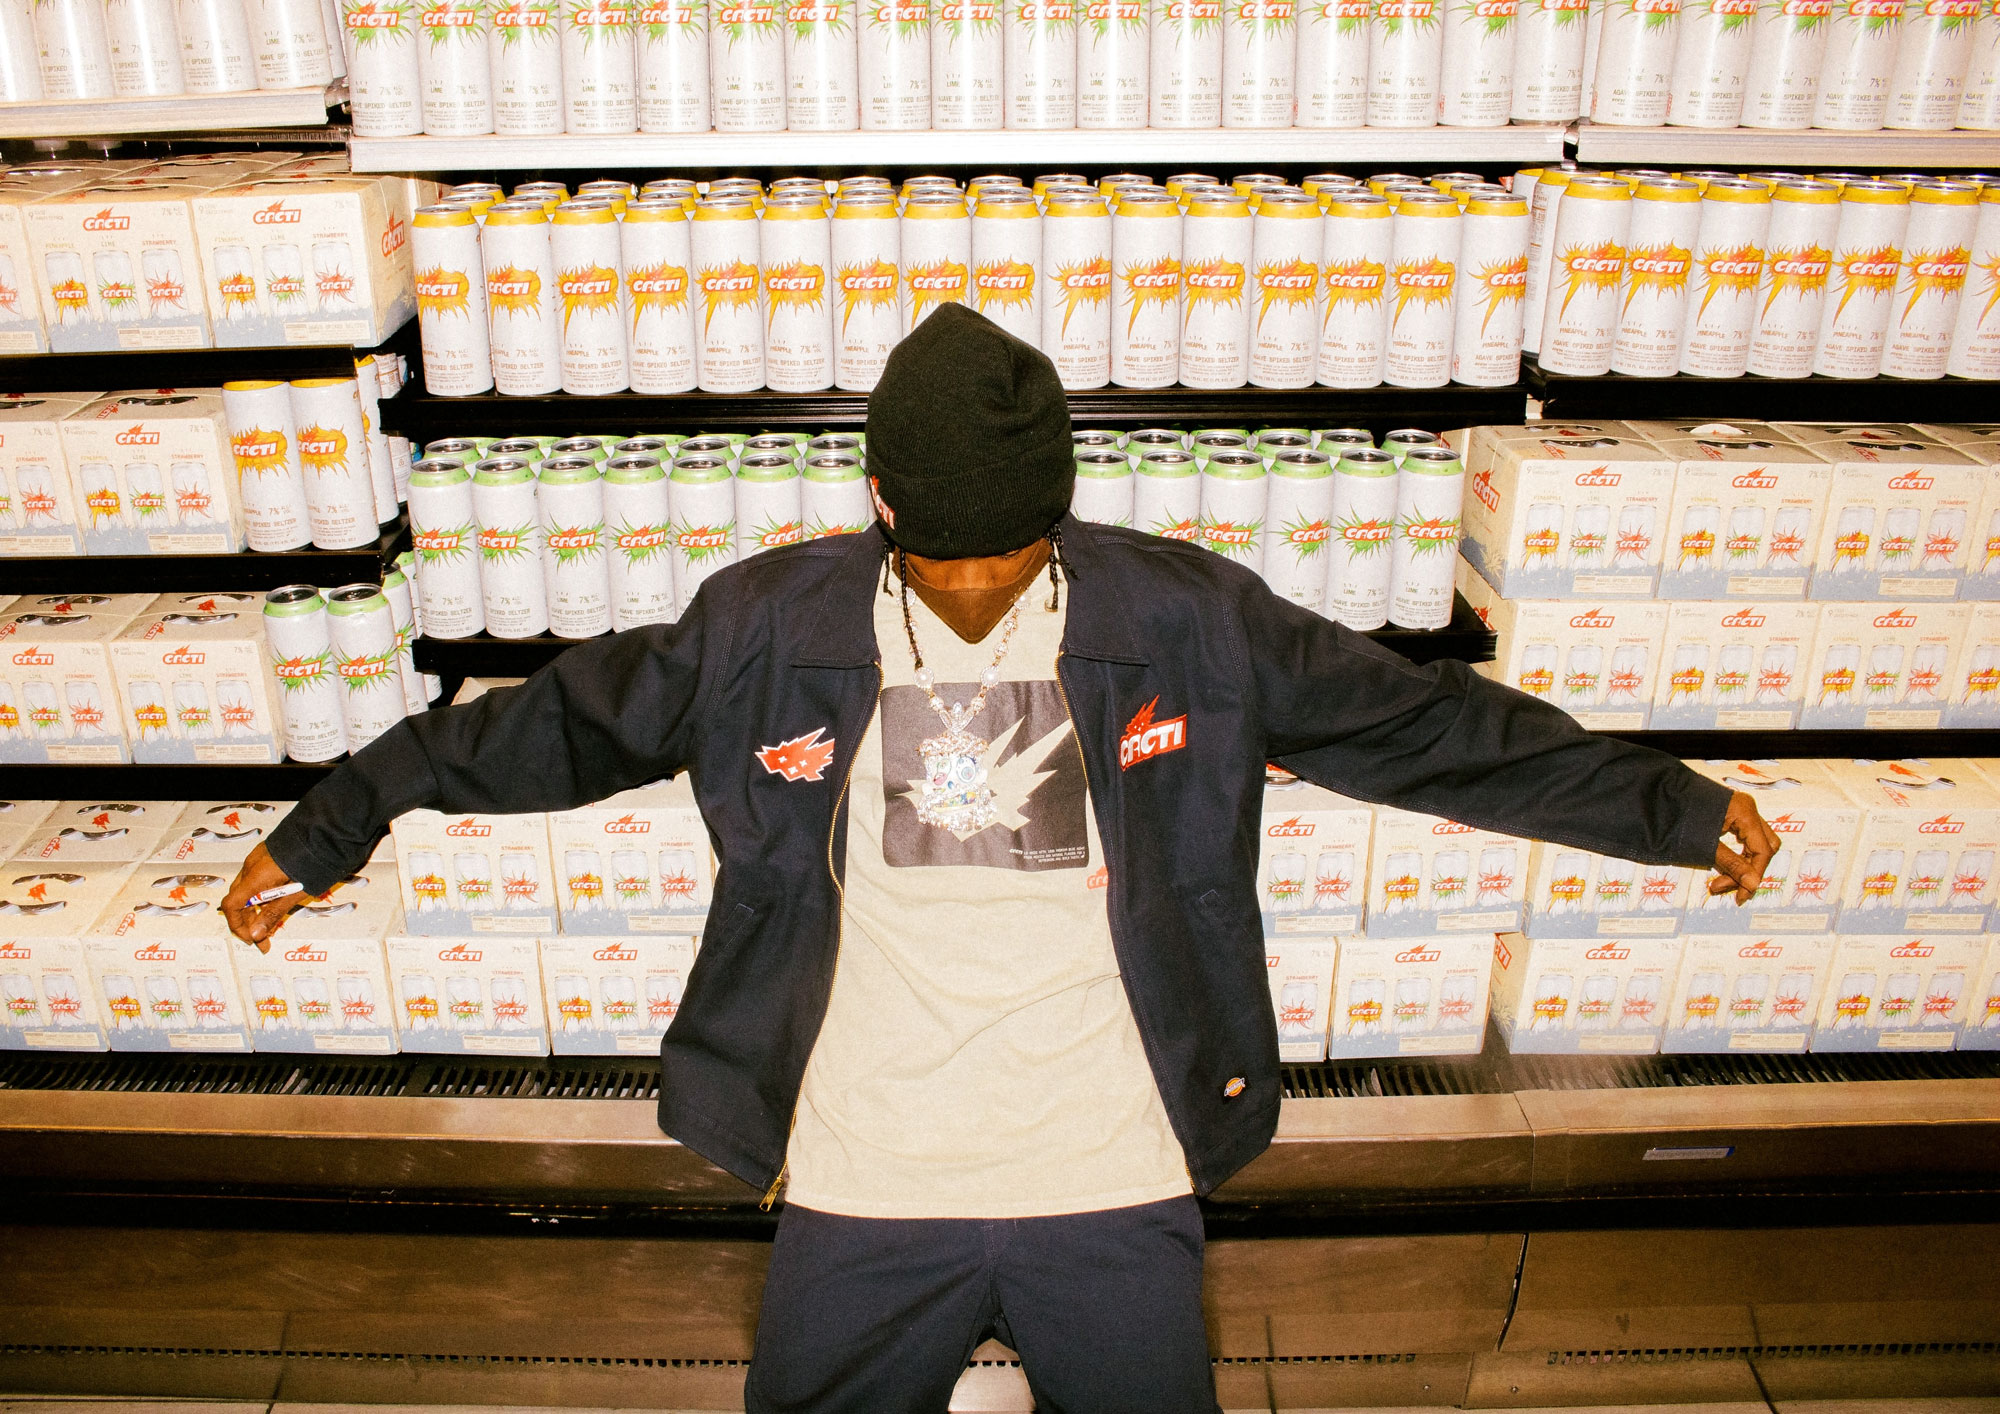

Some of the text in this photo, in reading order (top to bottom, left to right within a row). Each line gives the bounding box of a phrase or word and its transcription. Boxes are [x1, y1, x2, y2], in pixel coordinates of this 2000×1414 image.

[575, 8, 626, 25] CACTI
[641, 7, 691, 23] CACTI
[721, 6, 772, 23] CACTI
[787, 5, 837, 22] CACTI
[877, 5, 926, 22] CACTI
[942, 4, 994, 20] CACTI
[1087, 3, 1140, 19] CACTI
[1240, 2, 1292, 18] CACTI
[1379, 0, 1433, 18] CACTI
[347, 11, 399, 27] CACTI
[423, 10, 474, 26] CACTI
[496, 10, 546, 26] CACTI
[83, 216, 130, 231] CACTI
[253, 209, 301, 224] CACTI
[382, 221, 405, 257] CACTI
[1570, 257, 1619, 272] CACTI
[1632, 258, 1684, 274] CACTI
[1710, 259, 1760, 275] CACTI
[1774, 260, 1826, 276] CACTI
[1848, 261, 1898, 277] CACTI
[1917, 261, 1966, 277] CACTI
[562, 279, 611, 294] CACTI
[633, 278, 681, 292] CACTI
[705, 276, 753, 291] CACTI
[769, 277, 816, 291] CACTI
[844, 276, 892, 290] CACTI
[913, 275, 961, 290] CACTI
[978, 275, 1026, 289] CACTI
[1133, 272, 1178, 287] CACTI
[1188, 273, 1236, 288] CACTI
[1263, 273, 1312, 288] CACTI
[1329, 273, 1378, 288] CACTI
[1400, 272, 1448, 287] CACTI
[417, 283, 459, 296] CACTI
[116, 432, 160, 445] CACTI
[1575, 473, 1622, 486] CACTI
[1732, 476, 1778, 489] CACTI
[1888, 478, 1935, 490] CACTI
[1473, 473, 1500, 513] CACTI
[620, 531, 665, 547] CACTI
[679, 531, 725, 547] CACTI
[1204, 526, 1250, 543] CACTI
[1345, 526, 1390, 540] CACTI
[1408, 525, 1454, 539] CACTI
[415, 535, 459, 549] CACTI
[549, 533, 595, 547] CACTI
[1569, 615, 1615, 628] CACTI
[1721, 615, 1766, 628] CACTI
[1873, 616, 1917, 628] CACTI
[13, 654, 54, 665] CACTI
[163, 653, 205, 664] CACTI
[276, 661, 321, 677] CACTI
[340, 660, 385, 677] CACTI
[1120, 718, 1185, 768] CACTI
[446, 825, 491, 837] CACTI
[605, 821, 651, 833] CACTI
[1268, 824, 1315, 836] CACTI
[1919, 821, 1965, 834] CACTI
[135, 950, 176, 960] CACTI
[285, 951, 327, 961] CACTI
[439, 950, 482, 961] CACTI
[593, 949, 638, 960] CACTI
[1395, 951, 1441, 962] CACTI
[1586, 948, 1631, 959] CACTI
[1739, 947, 1783, 957] CACTI
[1890, 946, 1934, 957] CACTI
